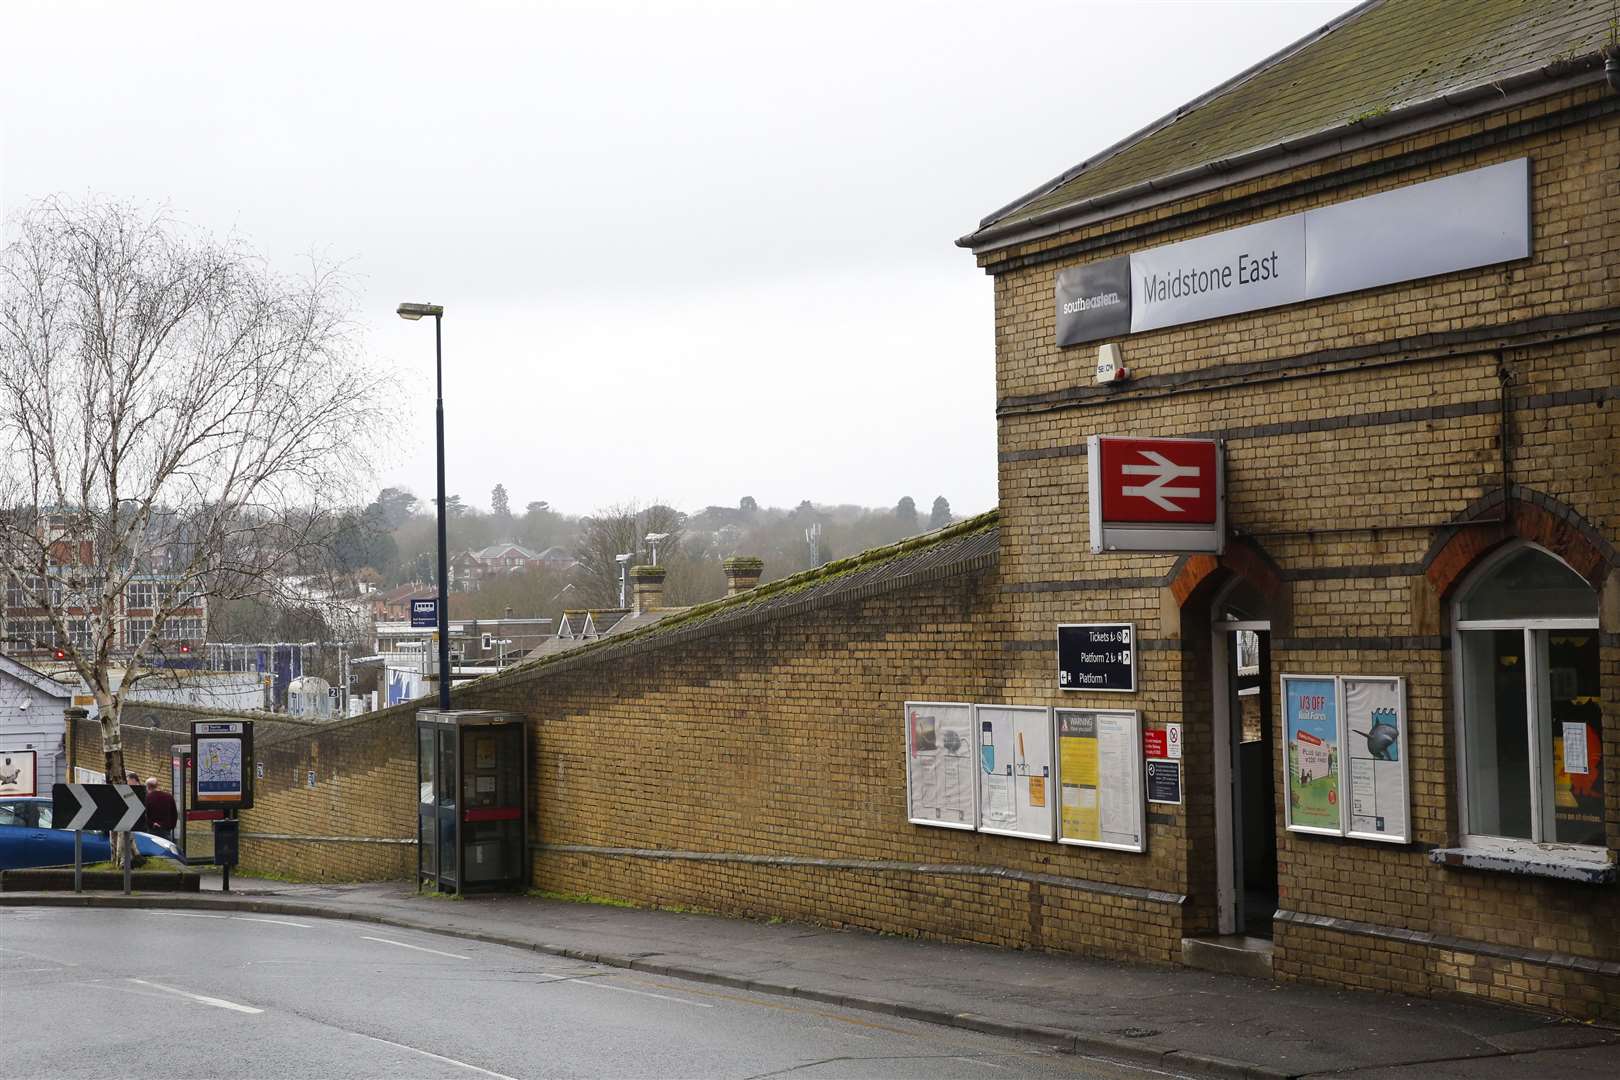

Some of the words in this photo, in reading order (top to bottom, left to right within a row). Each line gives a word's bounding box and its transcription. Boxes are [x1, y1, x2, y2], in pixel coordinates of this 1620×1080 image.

[1144, 268, 1232, 304] Maidstone
[1239, 251, 1279, 285] East
[1089, 631, 1109, 642] Tickets
[1080, 652, 1104, 663] Platform
[1105, 652, 1110, 663] 2
[1079, 672, 1103, 684] Platform
[1104, 673, 1108, 684] 1
[330, 688, 336, 697] 2
[1311, 695, 1325, 710] OFF
